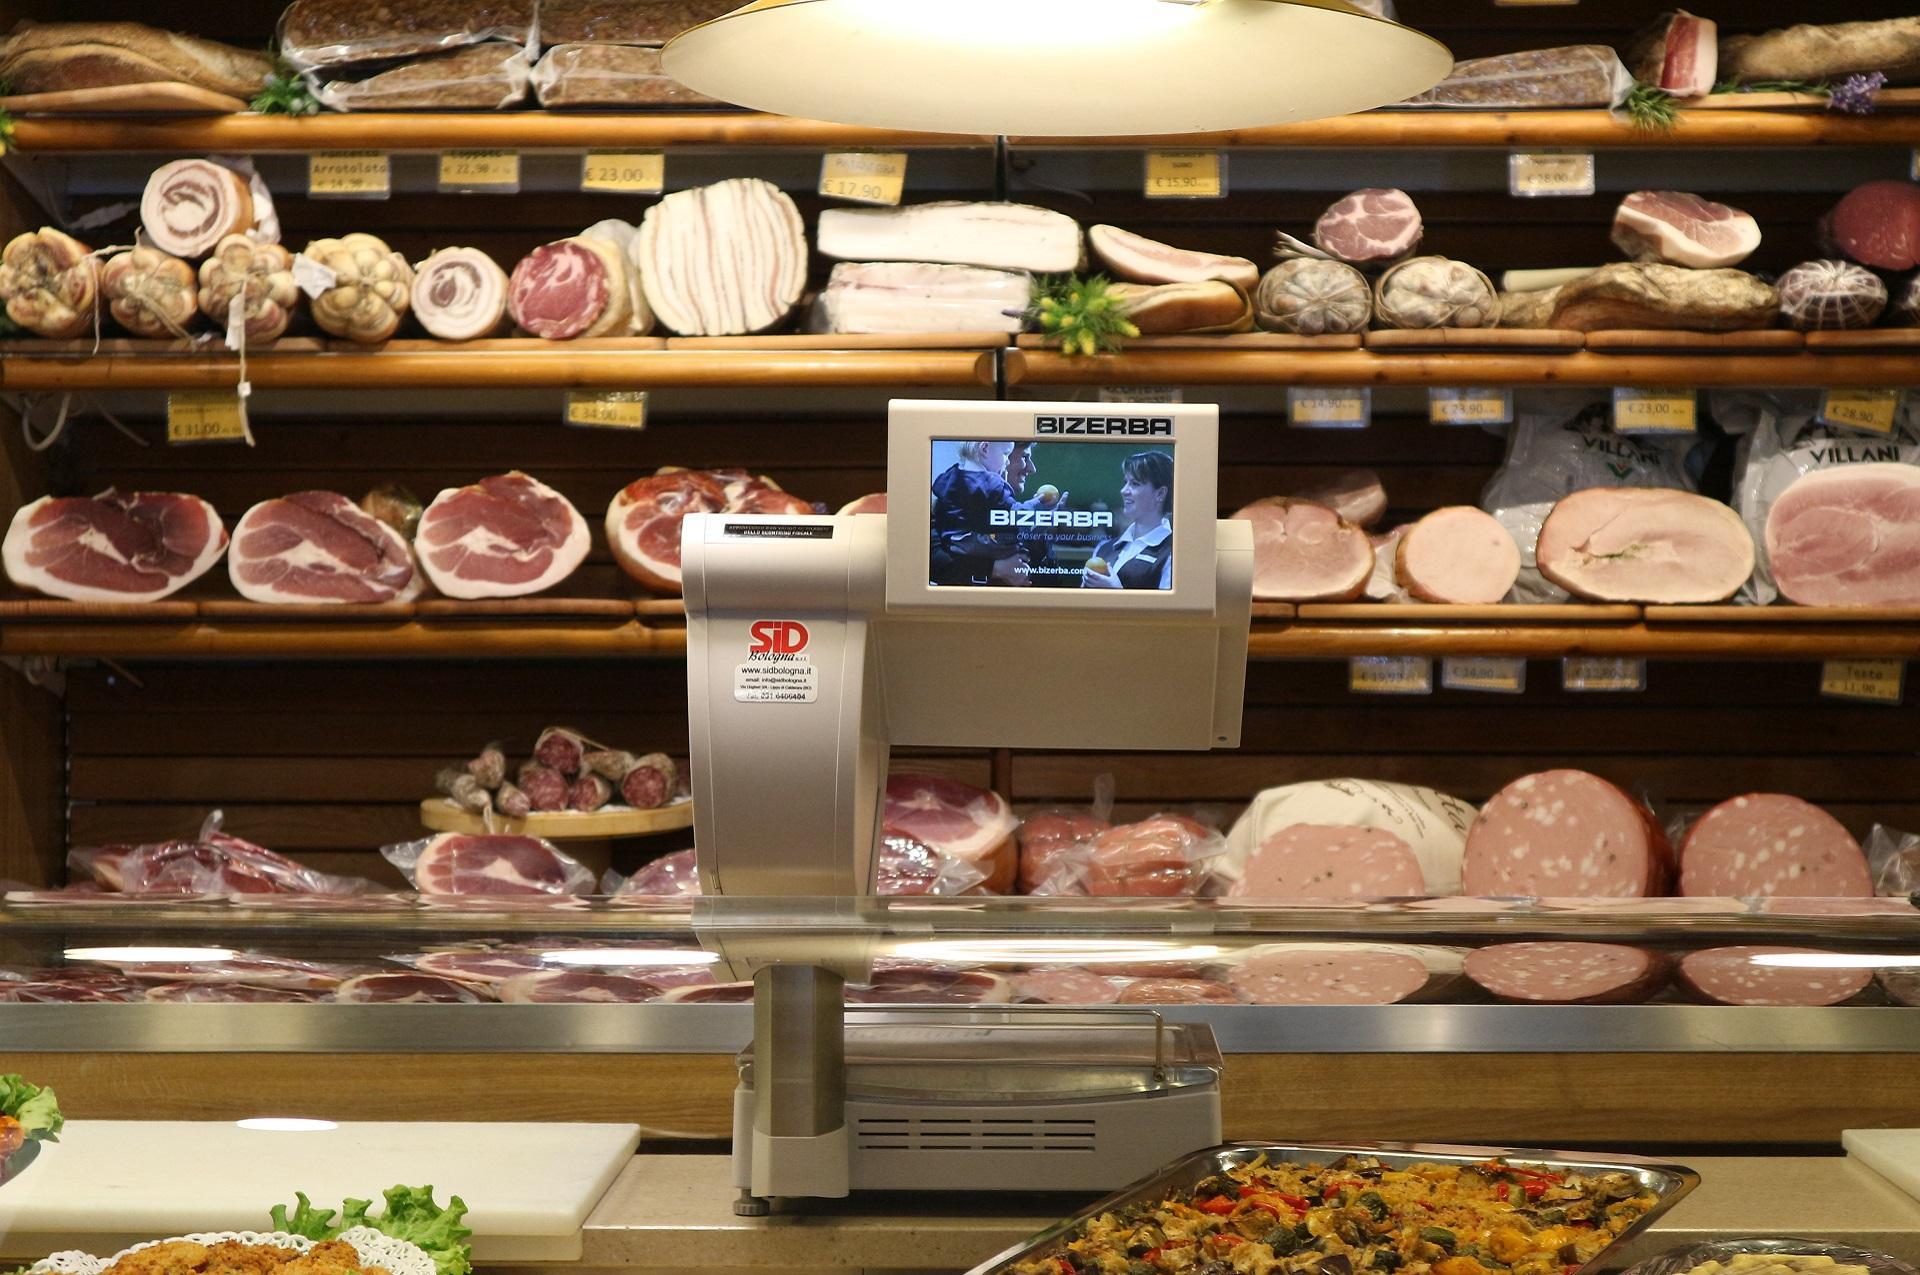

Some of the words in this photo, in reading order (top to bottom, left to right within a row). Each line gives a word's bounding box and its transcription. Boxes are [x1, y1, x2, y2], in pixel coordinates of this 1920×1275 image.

[599, 168, 644, 183] 23,00
[1036, 416, 1172, 435] BIZERBA
[1583, 435, 1660, 465] VILLANI
[1810, 446, 1900, 464] VILLANI
[990, 509, 1113, 527] BIZERBA
[1016, 532, 1041, 541] closer
[1055, 534, 1075, 543] your
[1077, 532, 1112, 541] business
[1014, 566, 1087, 575] www.bizerba.com
[748, 650, 795, 664] Bologna
[741, 666, 812, 676] www.sidbologna.it
